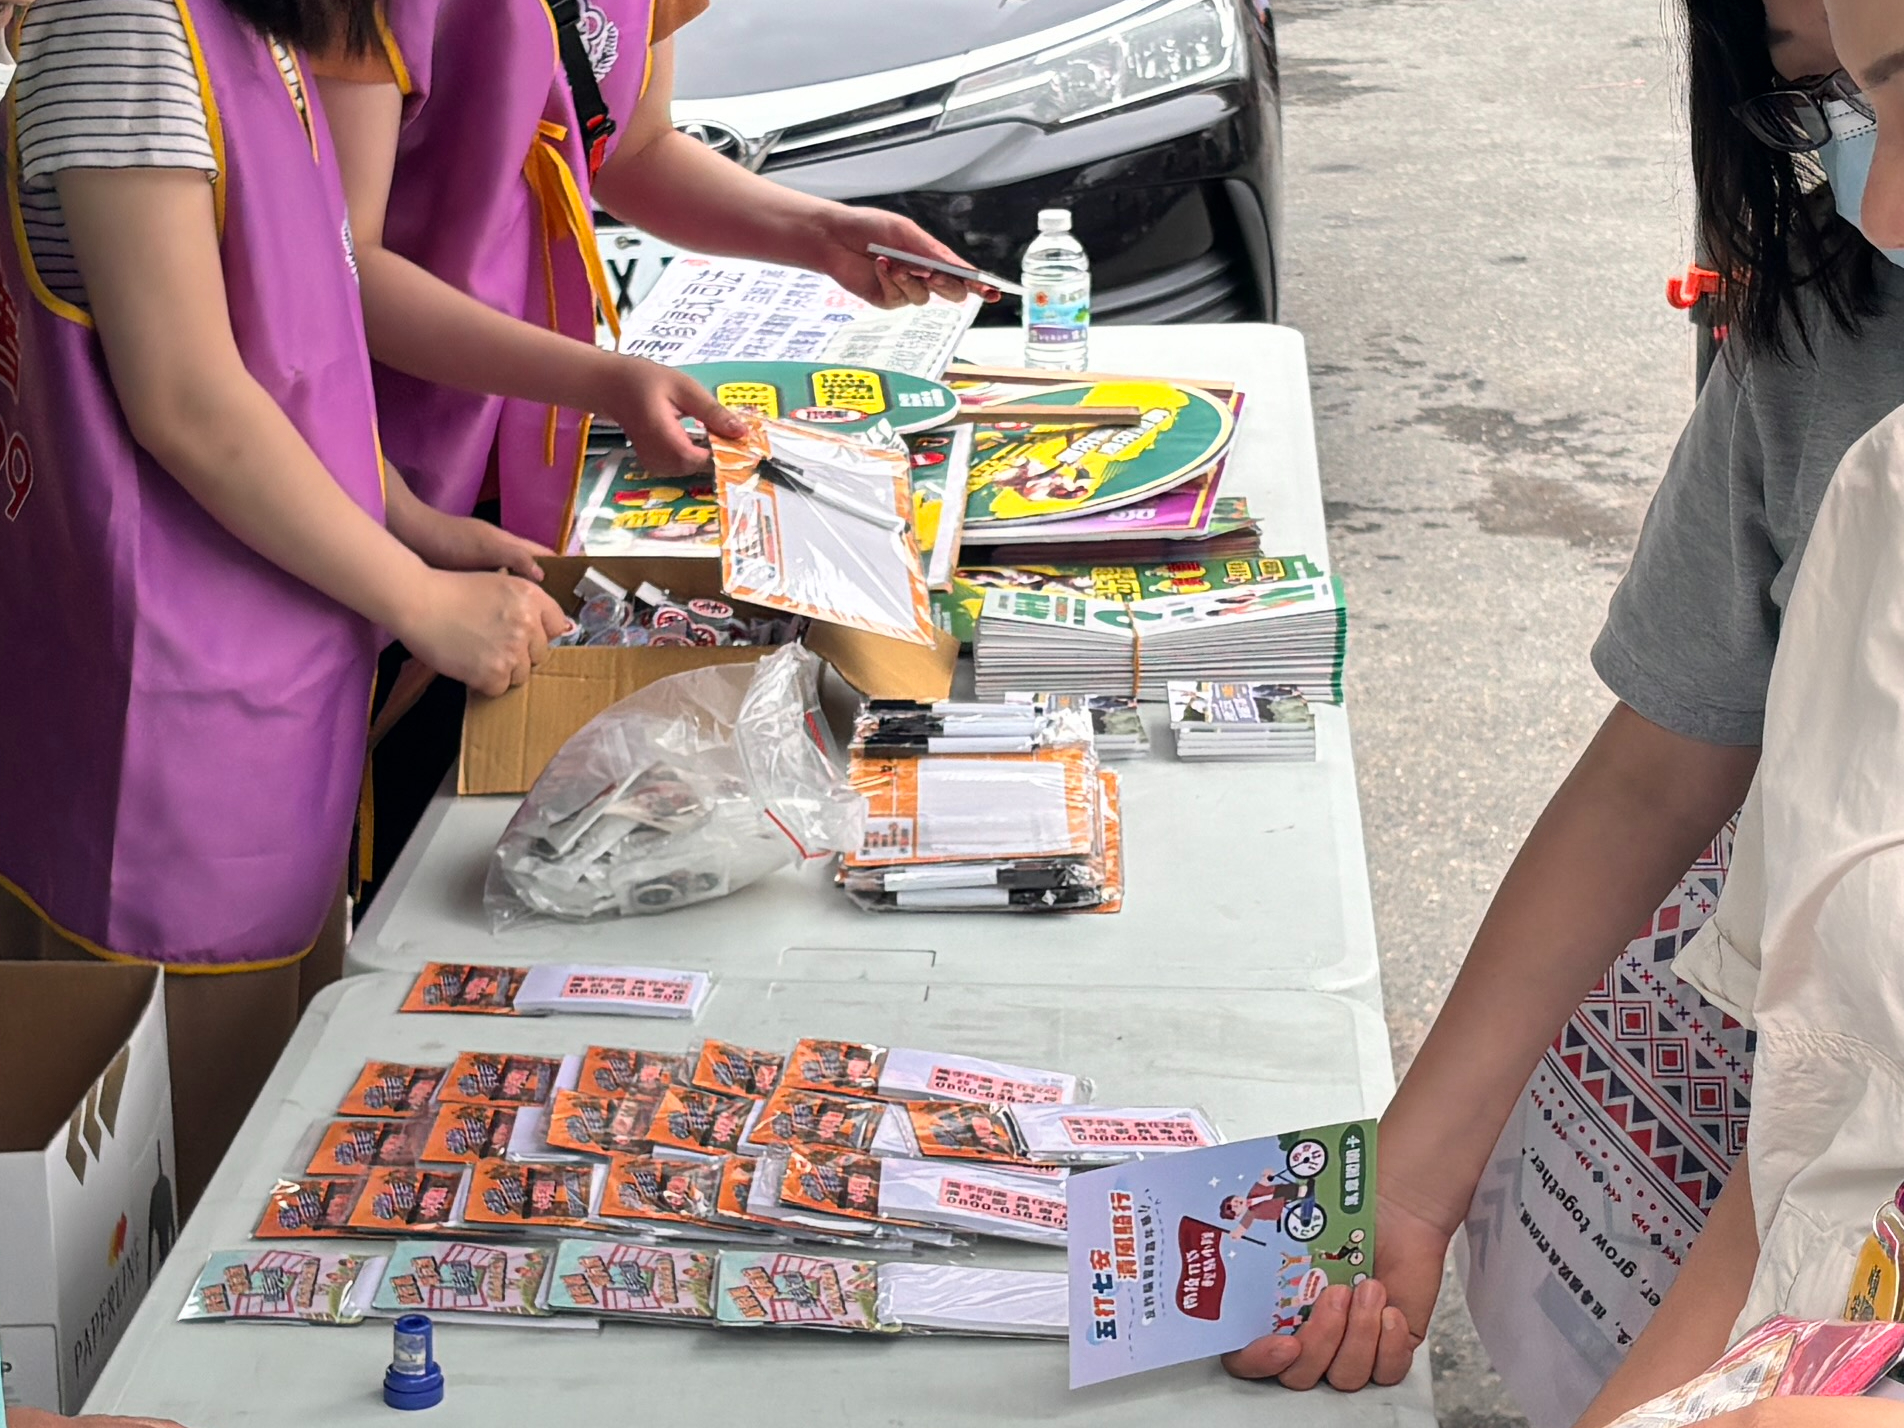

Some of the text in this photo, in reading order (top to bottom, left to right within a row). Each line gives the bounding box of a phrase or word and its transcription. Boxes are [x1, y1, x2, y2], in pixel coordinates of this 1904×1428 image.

[1530, 1147, 1592, 1236] together.
[1089, 1248, 1118, 1341] 五打七安
[1591, 1232, 1638, 1280] grow
